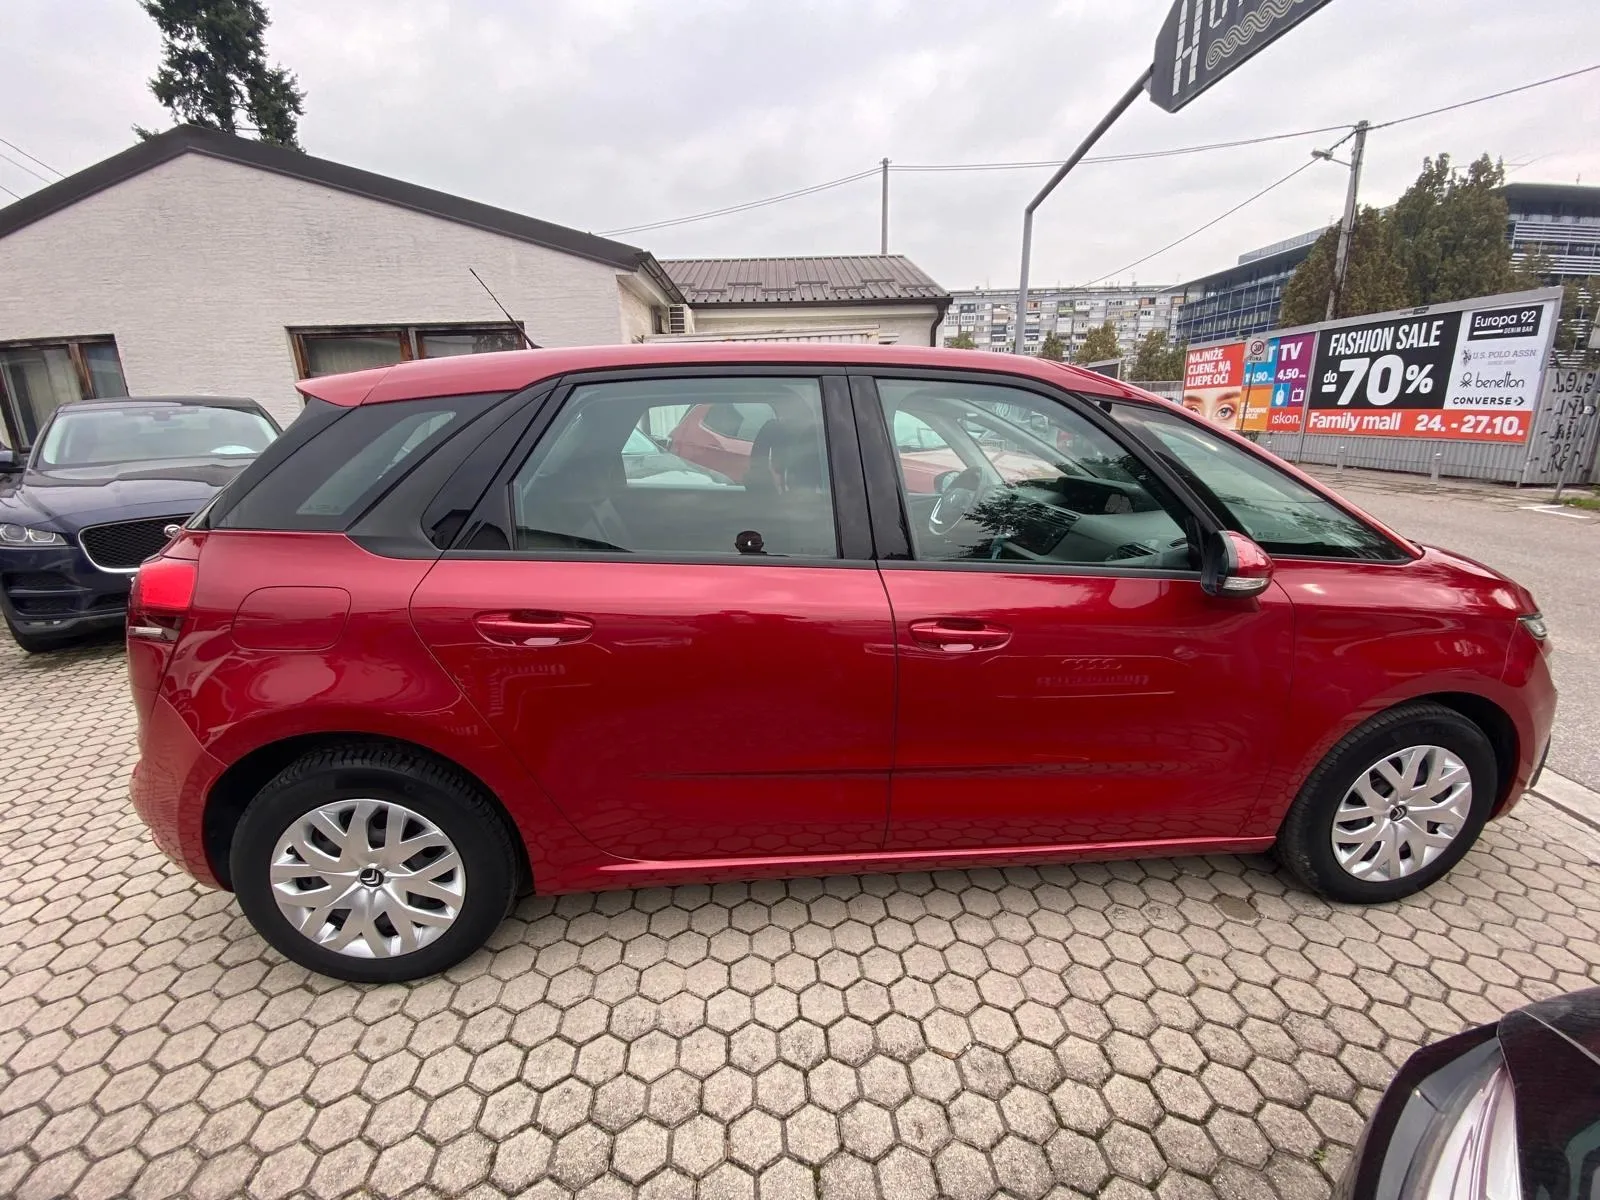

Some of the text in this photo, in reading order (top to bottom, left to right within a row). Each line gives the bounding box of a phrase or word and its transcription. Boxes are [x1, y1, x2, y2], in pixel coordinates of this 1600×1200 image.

[1474, 311, 1536, 328] Europa 92
[1328, 320, 1444, 356] FASHION SALE
[1254, 343, 1262, 352] 30
[1280, 342, 1303, 361] TV
[1488, 351, 1510, 359] POLO
[1189, 348, 1224, 363] NAJNIŽE
[1187, 360, 1231, 375] CIJENE, NA
[1277, 368, 1299, 381] 4,50
[1186, 371, 1229, 387] LIJEPE OČI
[1323, 370, 1337, 383] do
[1475, 371, 1525, 388] benetton
[1453, 396, 1512, 405] CONVERSE
[1309, 411, 1401, 431] Family mall
[1415, 414, 1446, 432] 24.
[1460, 415, 1525, 436] 27.10.
